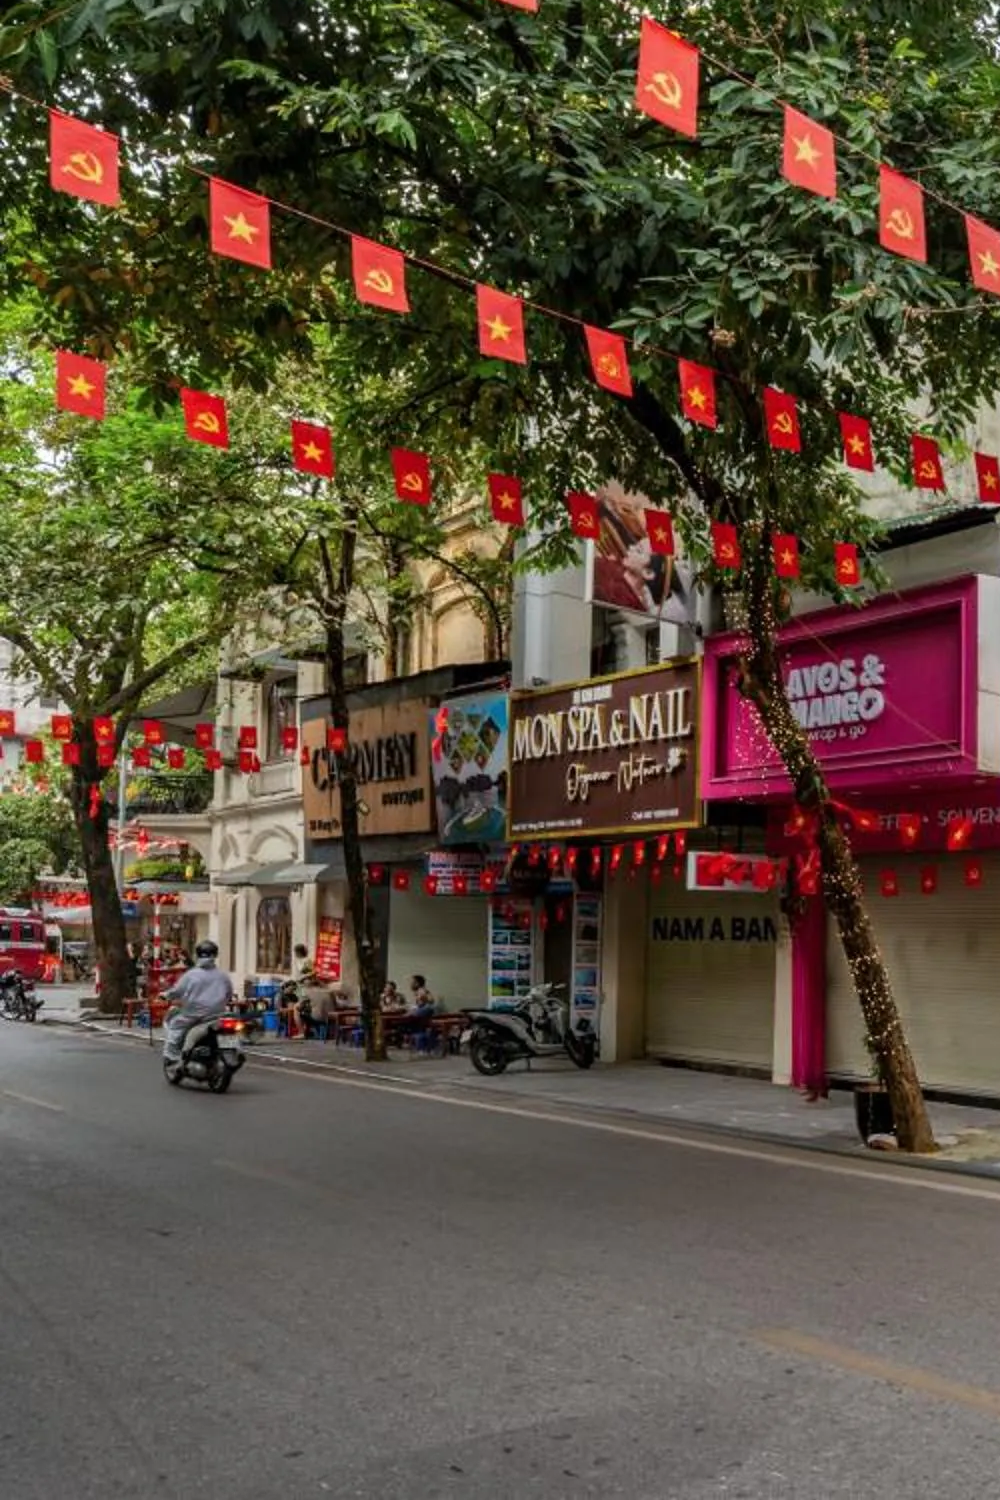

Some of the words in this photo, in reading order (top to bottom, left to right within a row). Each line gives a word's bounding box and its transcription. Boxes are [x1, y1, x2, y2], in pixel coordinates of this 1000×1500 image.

[787, 658, 857, 699] AVOS
[860, 654, 886, 686] &
[512, 711, 564, 763] MON
[567, 704, 608, 752] SPA
[609, 709, 629, 747] &
[629, 687, 692, 743] NAIL
[653, 917, 704, 941] NAM
[709, 917, 725, 941] A
[731, 917, 778, 942] BAN
